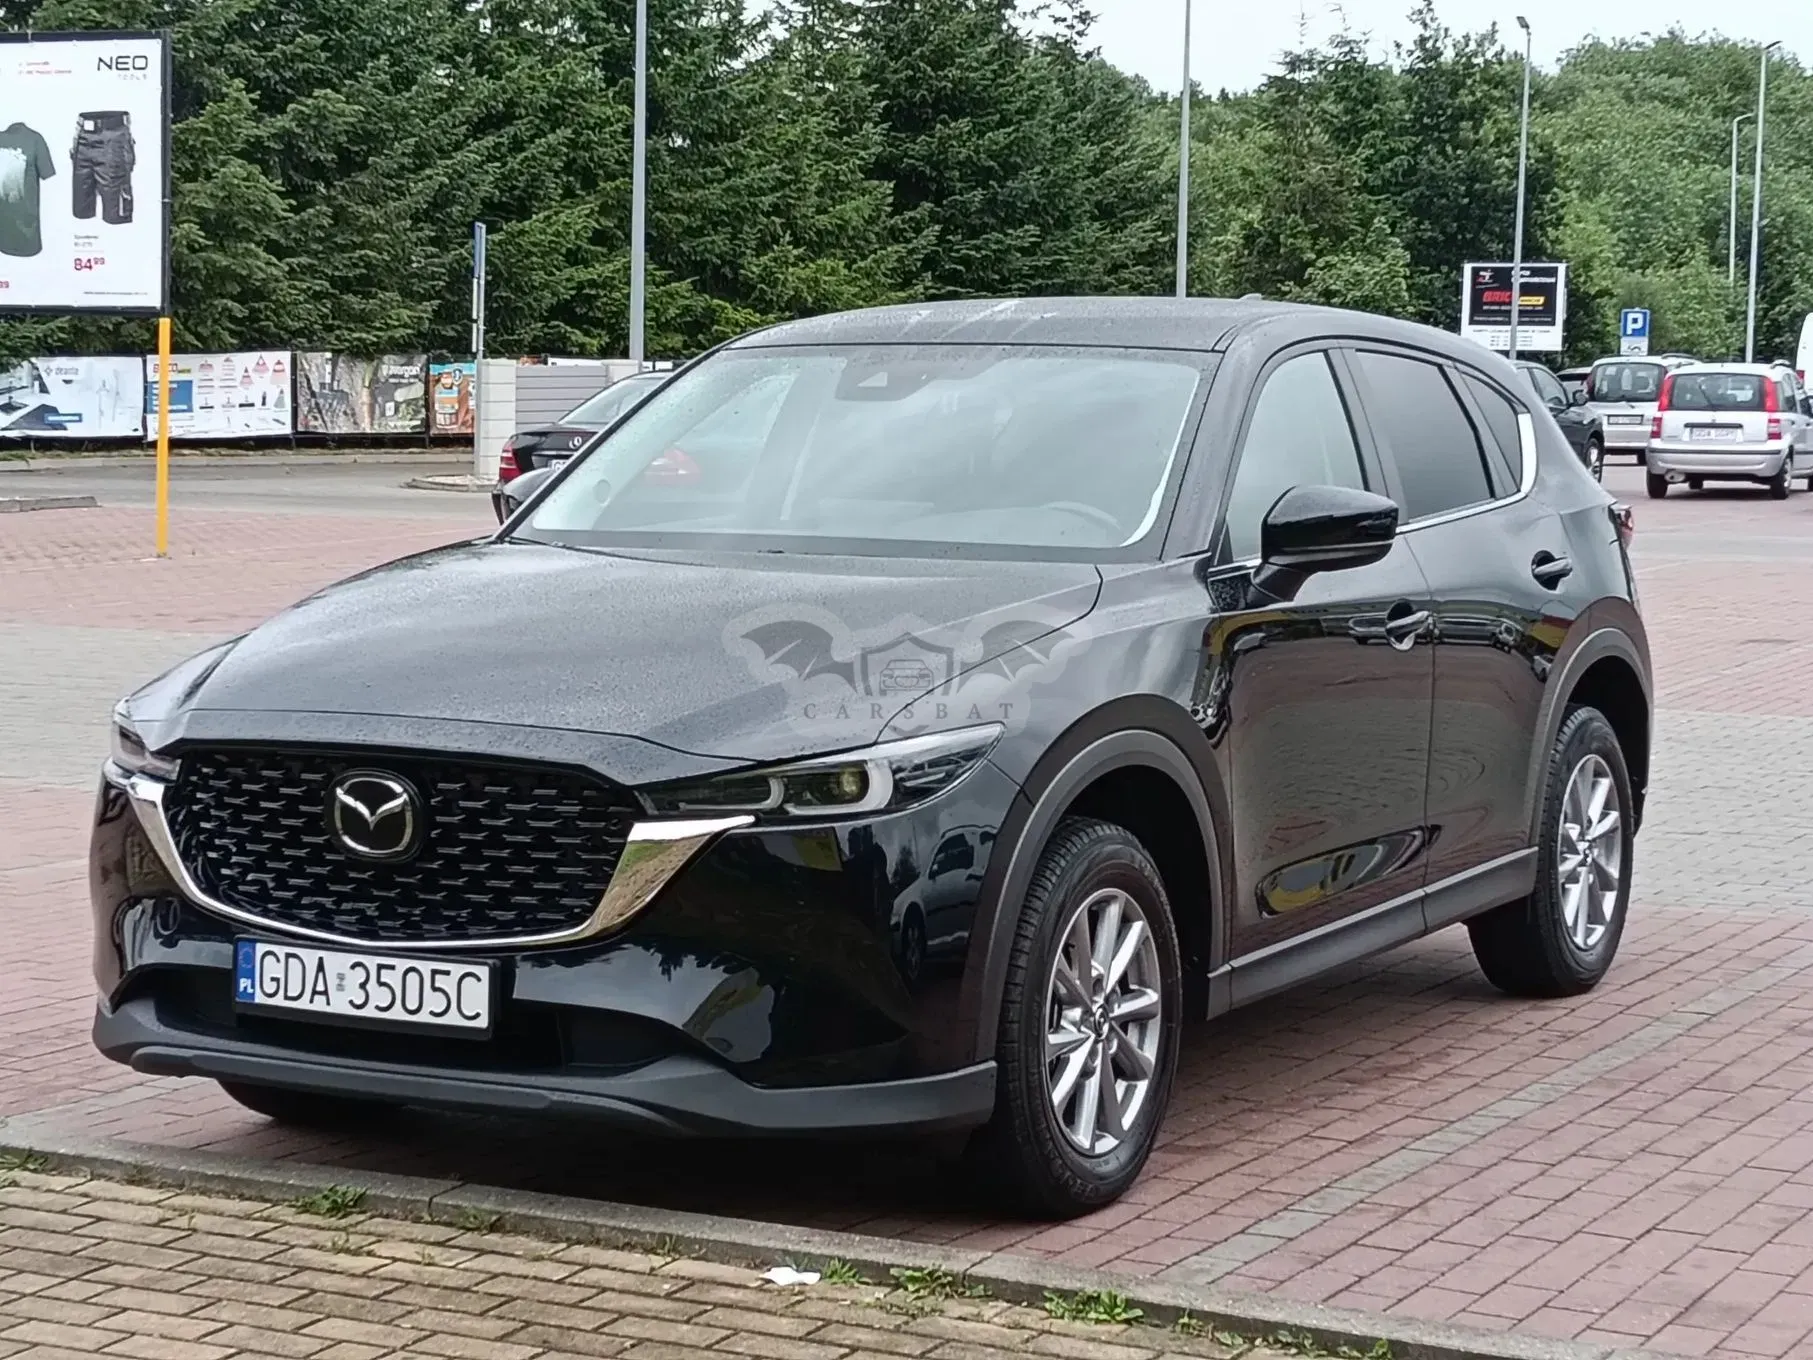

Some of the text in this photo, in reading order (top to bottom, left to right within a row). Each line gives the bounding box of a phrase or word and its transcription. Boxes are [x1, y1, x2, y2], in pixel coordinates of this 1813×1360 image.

[97, 55, 149, 71] NEO
[1626, 312, 1644, 335] P
[239, 977, 254, 993] PL
[259, 949, 482, 1021] GDA 3505C
